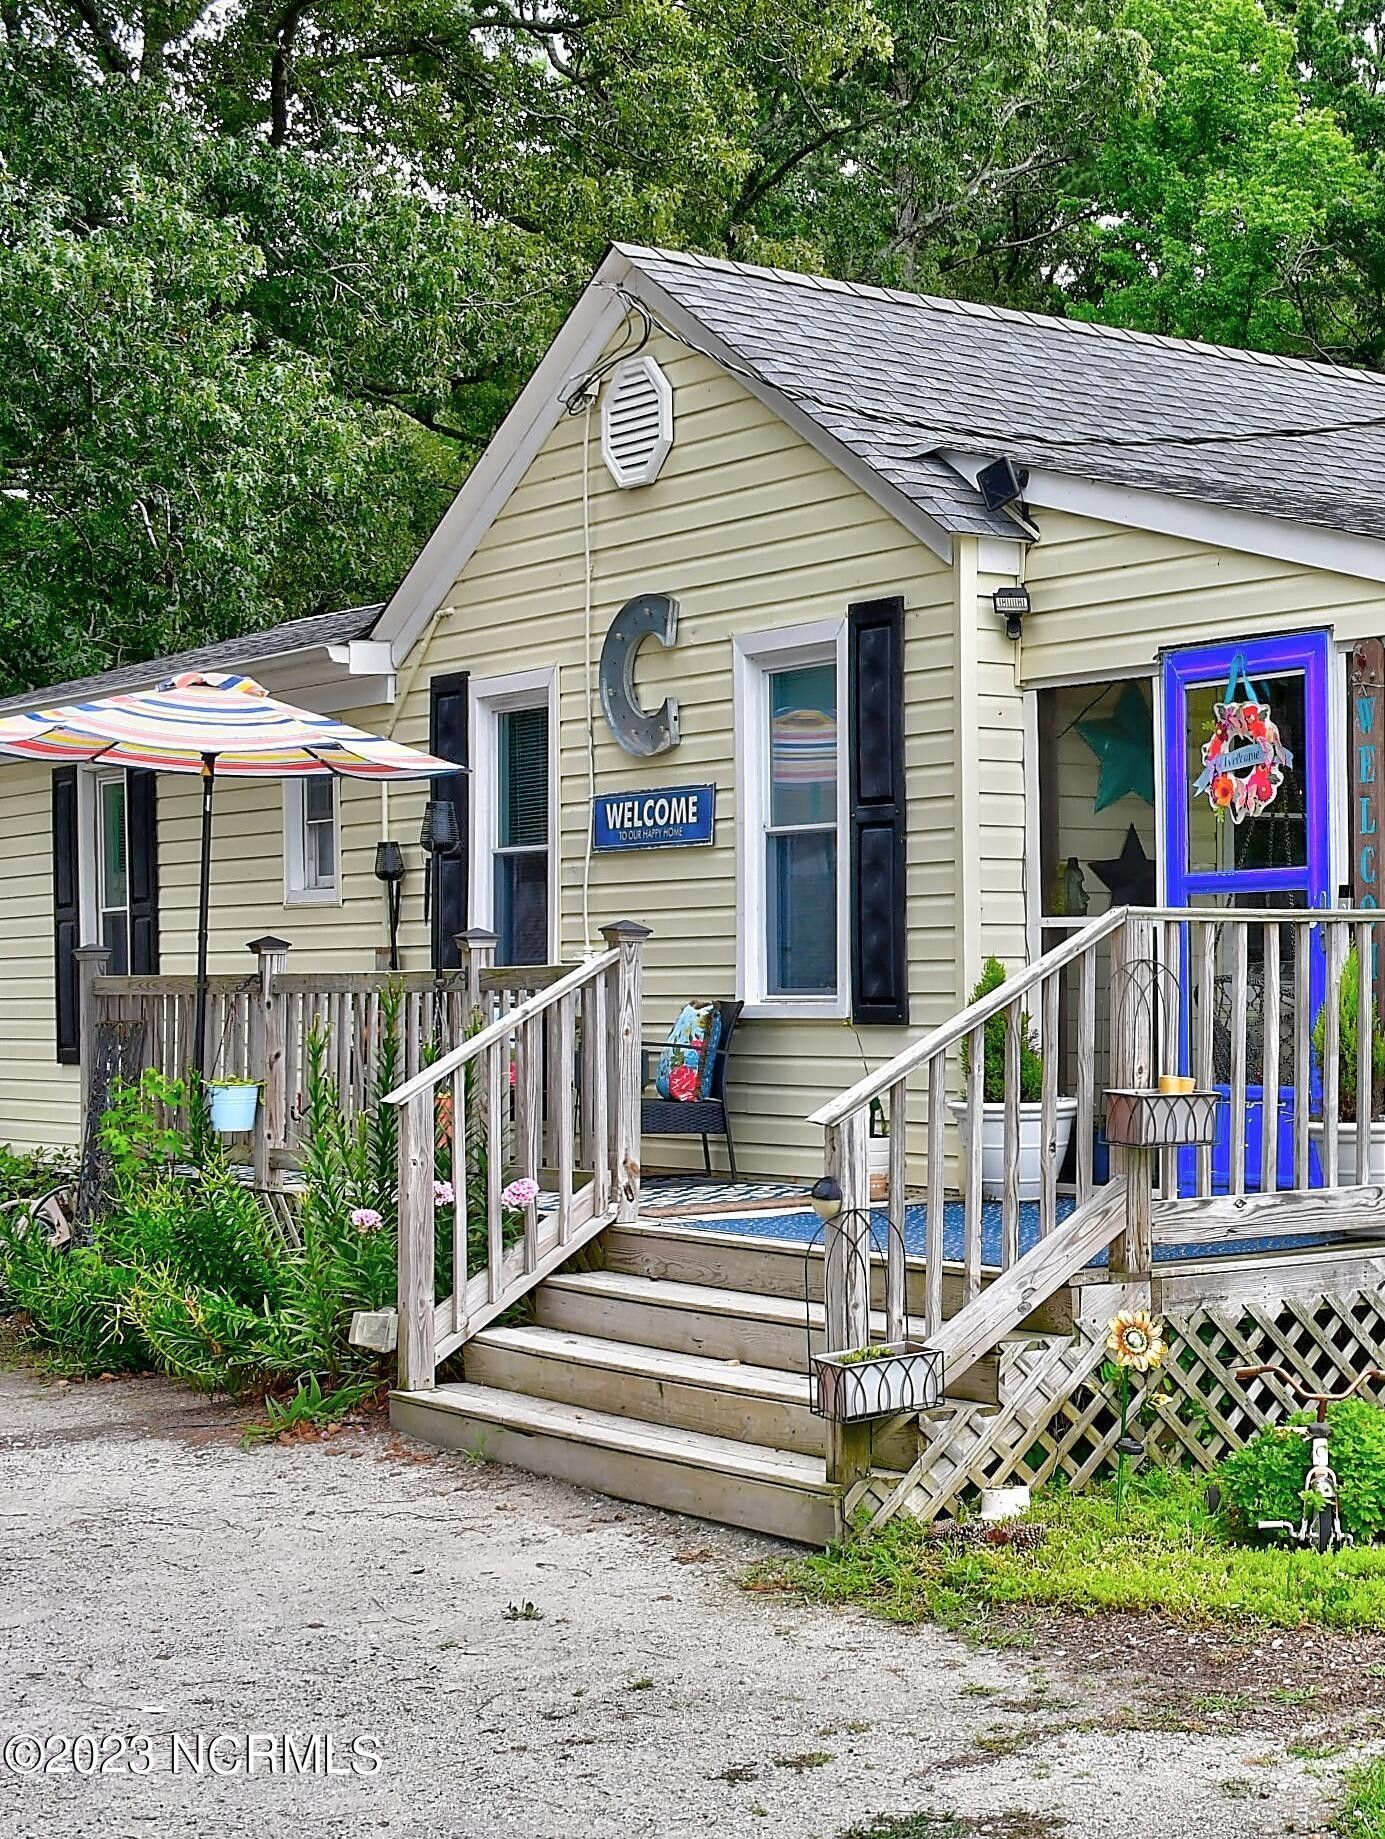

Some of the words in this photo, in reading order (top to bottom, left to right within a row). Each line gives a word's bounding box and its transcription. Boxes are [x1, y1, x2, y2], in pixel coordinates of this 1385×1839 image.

[599, 594, 680, 757] C
[606, 795, 698, 830] WELCOME
[619, 831, 628, 840] TO
[628, 829, 641, 840] OUR
[642, 827, 661, 839] HAPPY
[663, 826, 683, 838] HOME
